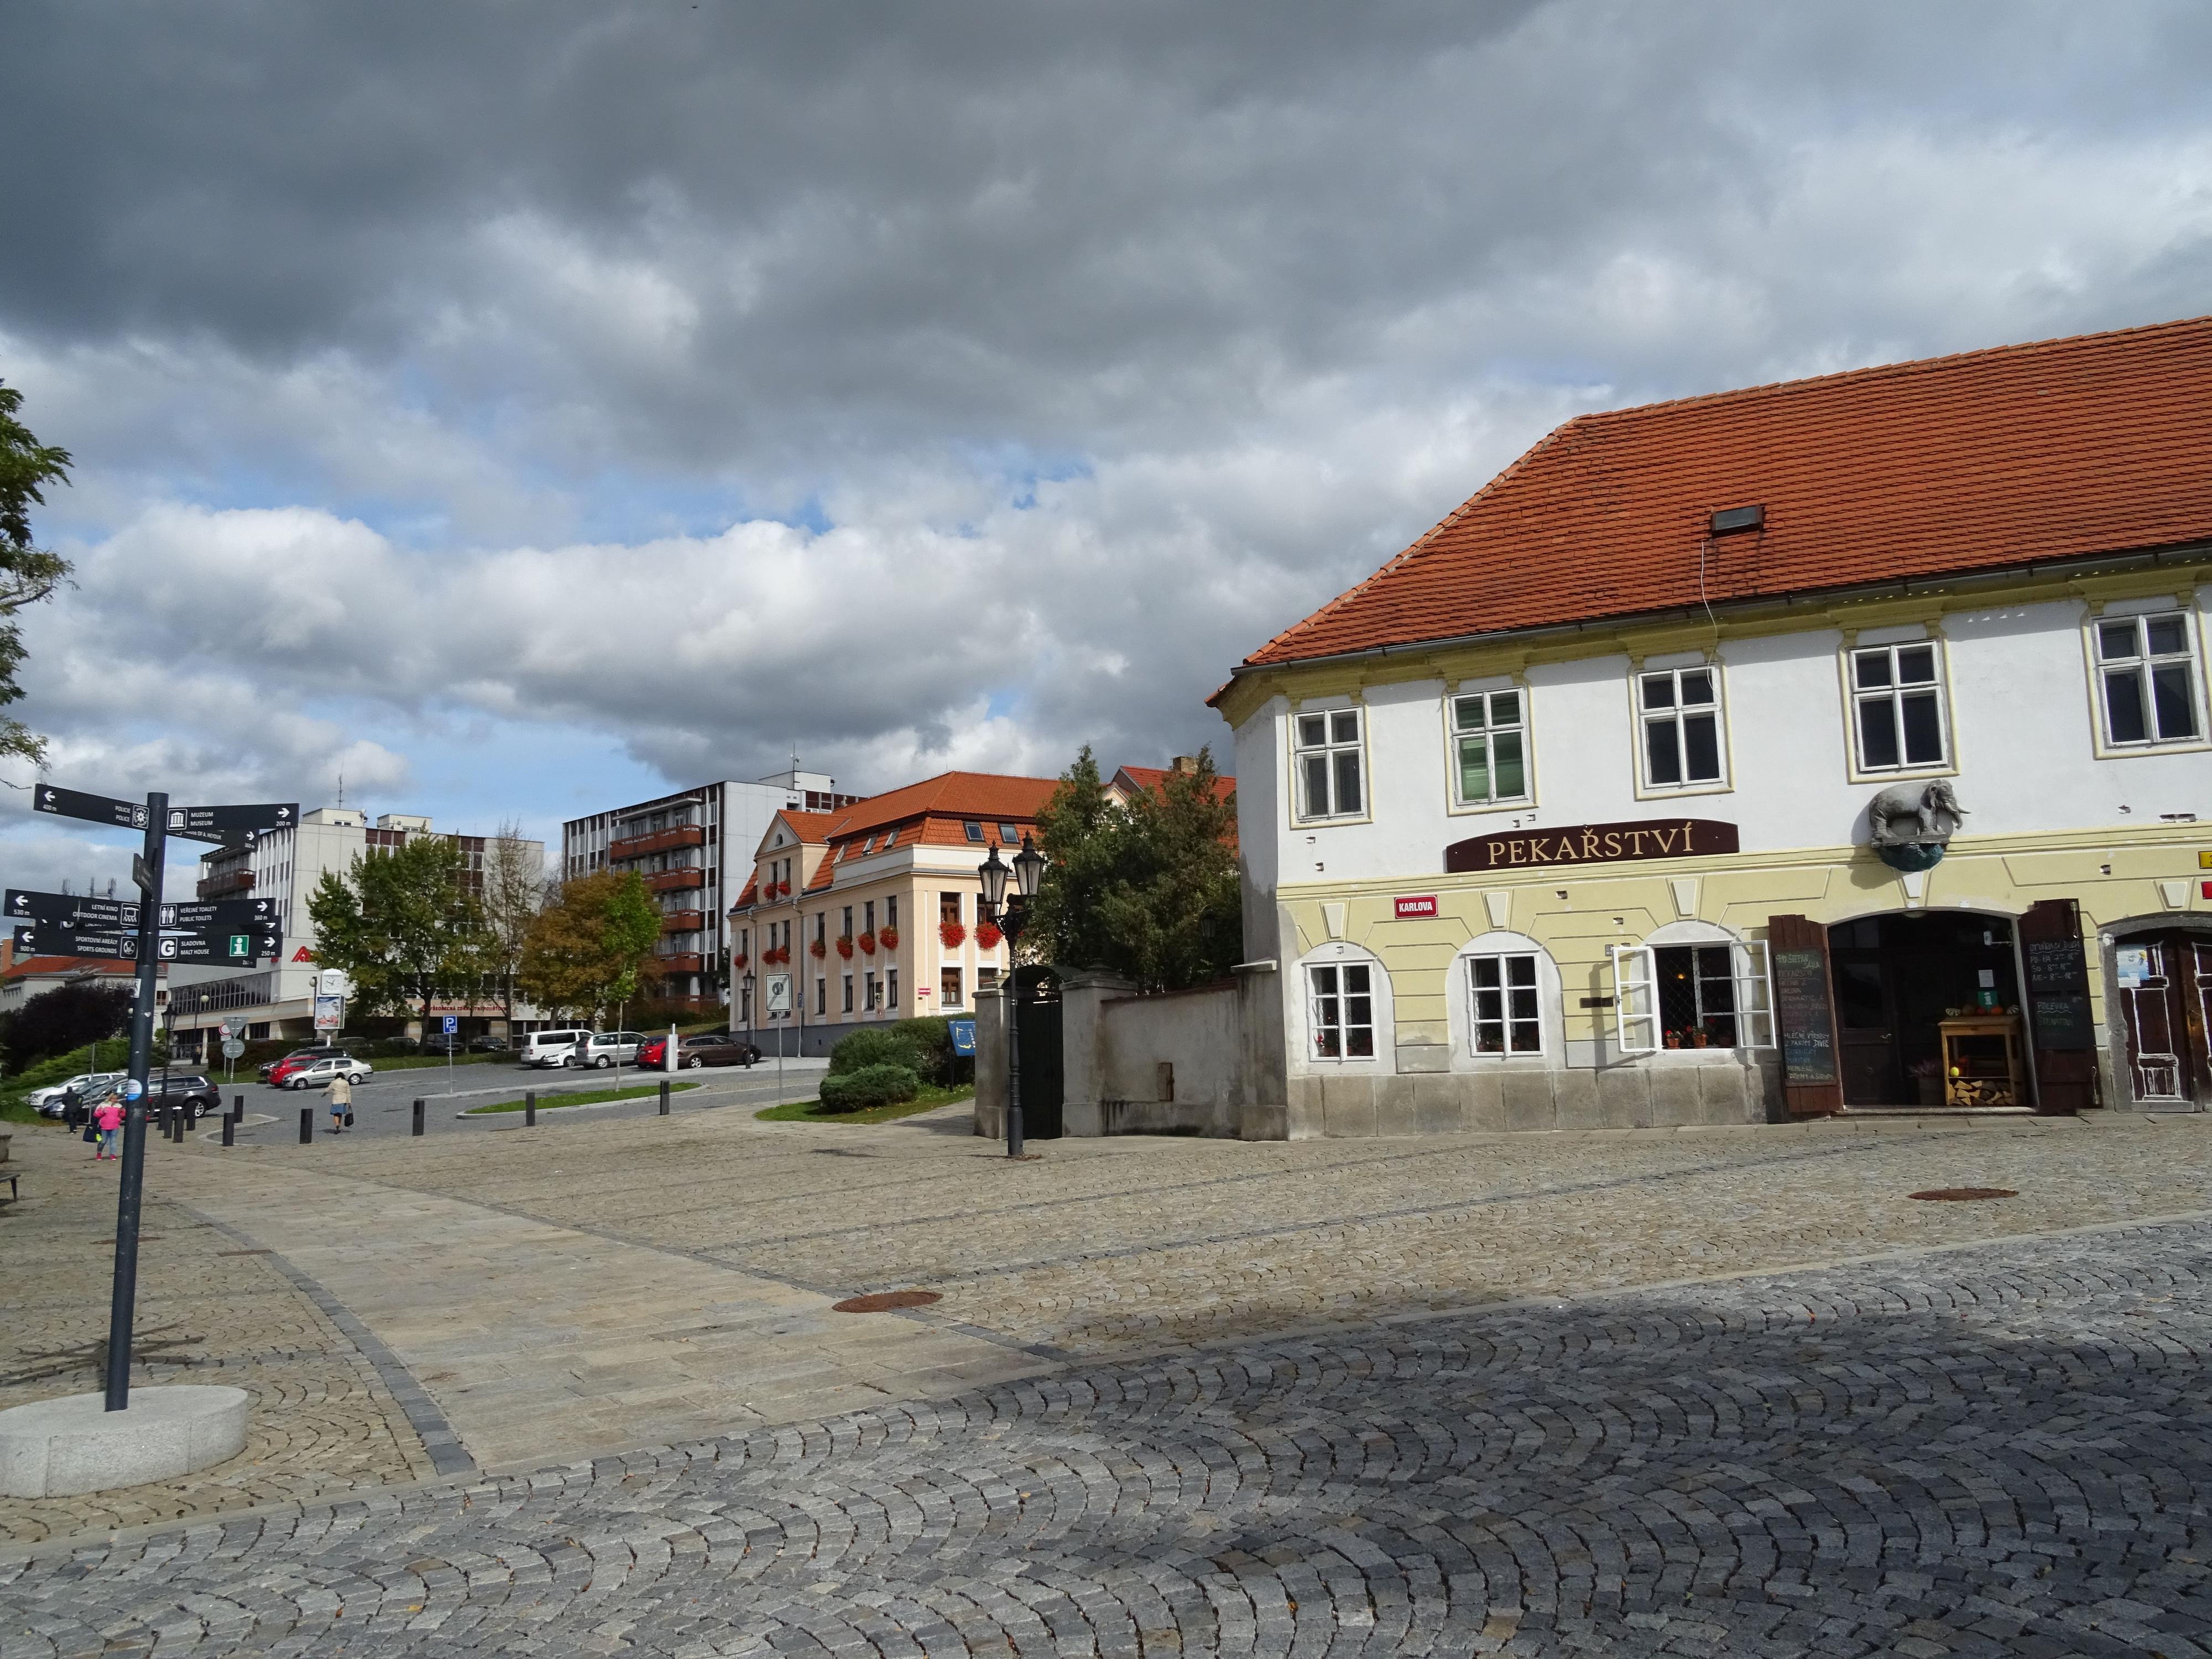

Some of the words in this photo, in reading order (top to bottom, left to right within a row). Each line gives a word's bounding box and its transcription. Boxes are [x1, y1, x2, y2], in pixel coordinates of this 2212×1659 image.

[1487, 821, 1694, 865] PEKAŘSTVÍ
[1399, 901, 1433, 912] KARLOVA
[161, 940, 175, 956] G
[446, 1018, 454, 1028] P
